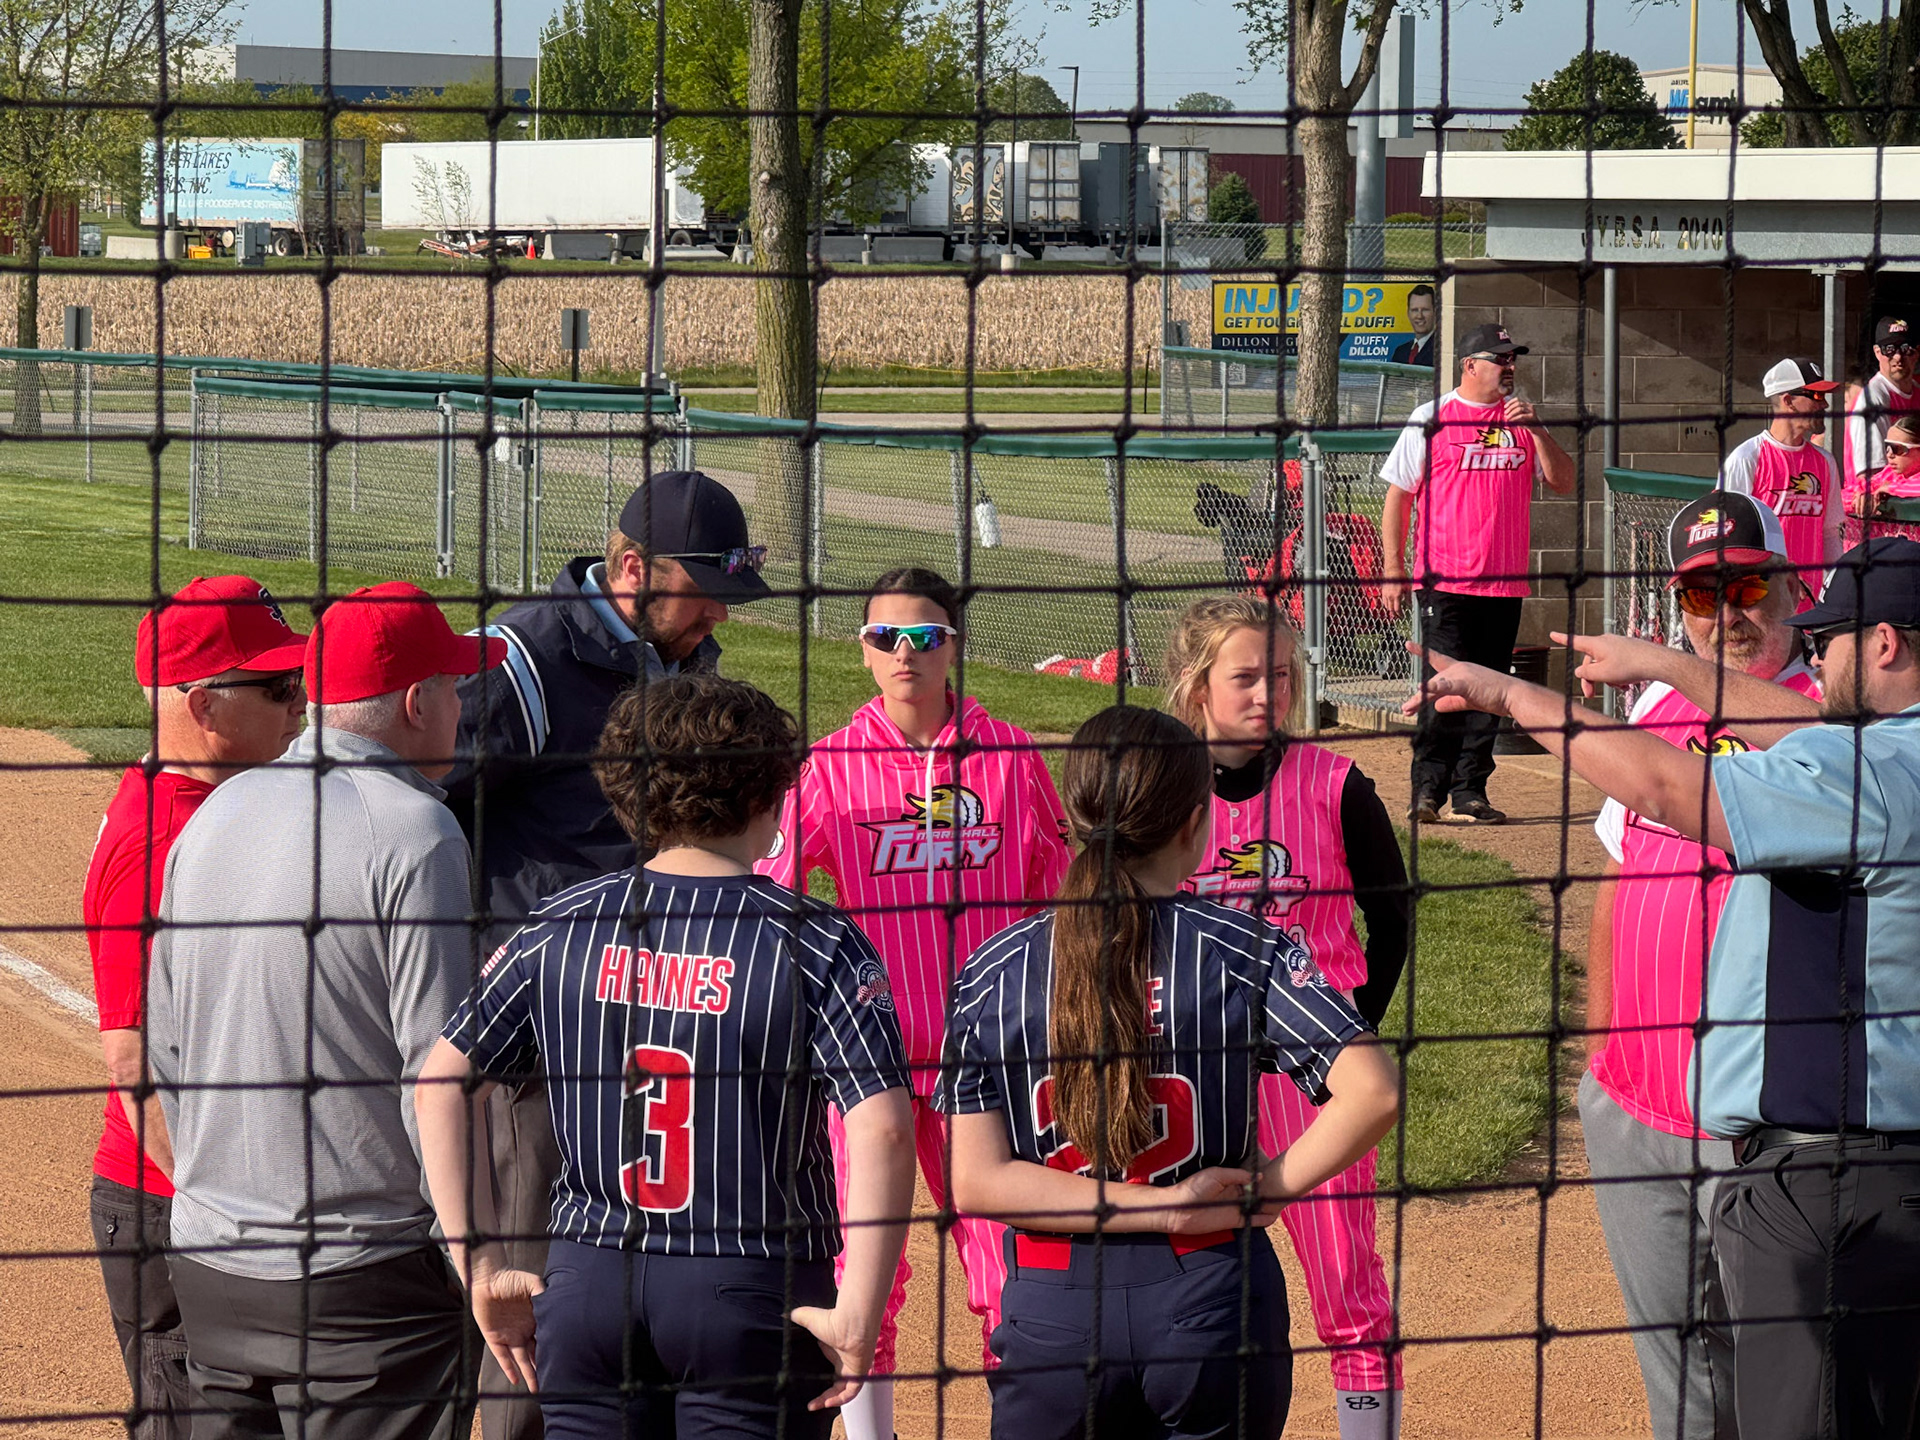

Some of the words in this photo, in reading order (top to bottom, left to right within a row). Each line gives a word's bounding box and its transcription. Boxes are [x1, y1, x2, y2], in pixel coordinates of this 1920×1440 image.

[193, 151, 232, 169] LAKES
[204, 199, 252, 209] FOODSERVICE
[1677, 216, 1723, 251] 2010
[1224, 288, 1384, 313] INJUD?
[1224, 317, 1253, 328] GET
[1354, 316, 1395, 328] DUFF!
[1222, 337, 1270, 347] DILLON
[1354, 336, 1389, 345] DUFFY
[1349, 346, 1389, 356] DILLON
[1458, 442, 1527, 470] FURY
[872, 822, 1001, 873] FURY
[1229, 879, 1306, 890] MARHALL
[596, 944, 735, 1015] HAINES
[619, 1044, 694, 1214] 3
